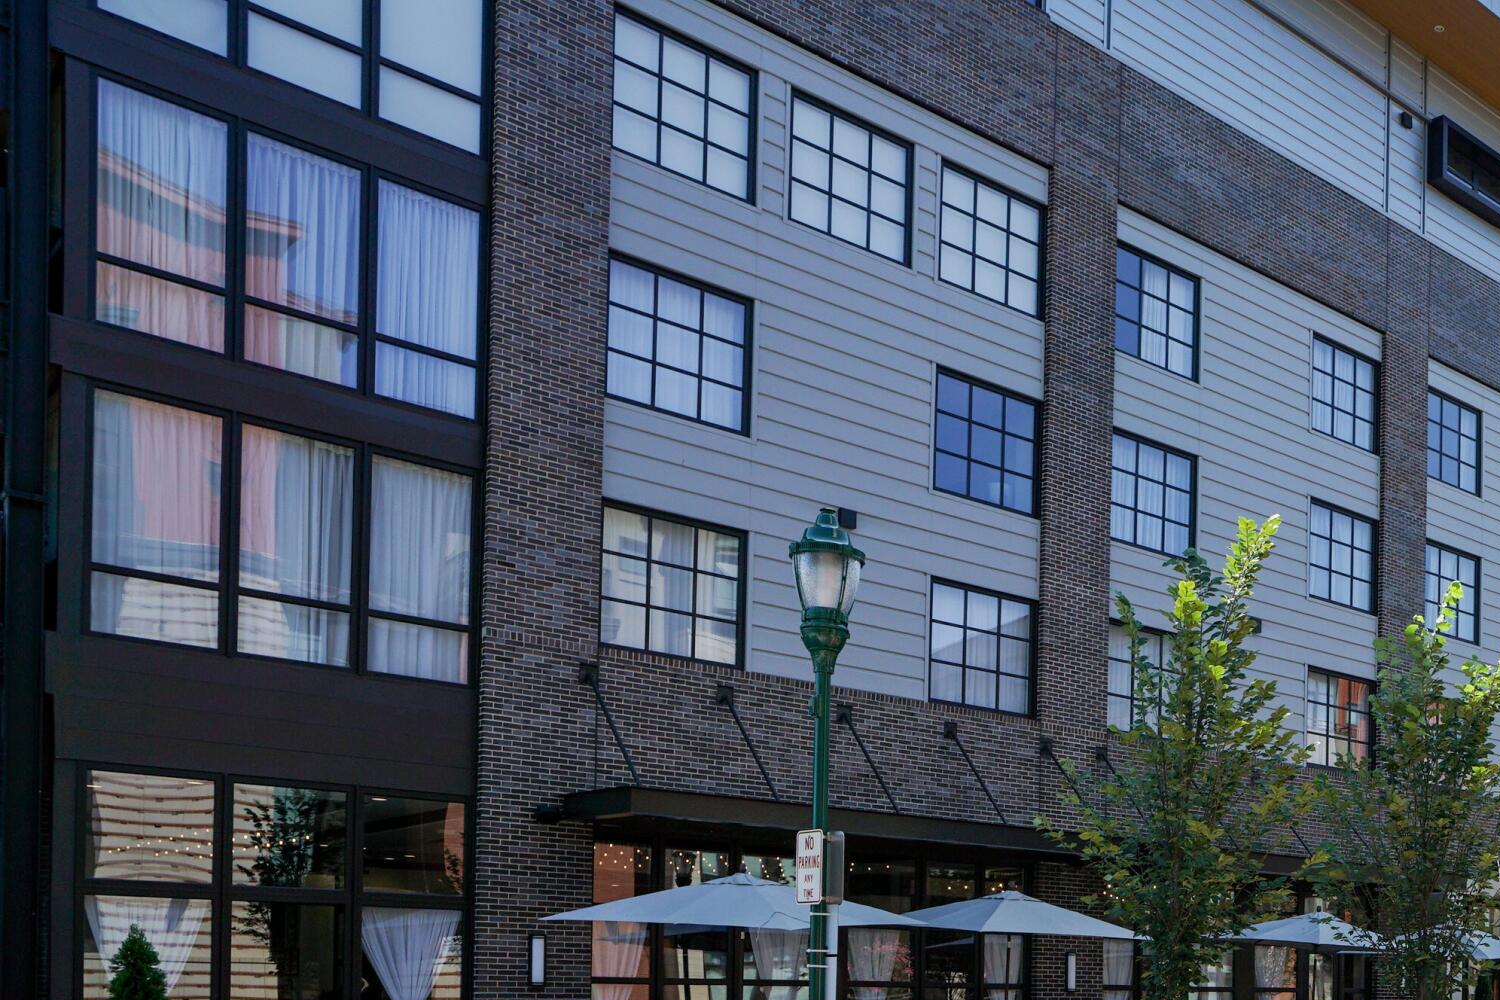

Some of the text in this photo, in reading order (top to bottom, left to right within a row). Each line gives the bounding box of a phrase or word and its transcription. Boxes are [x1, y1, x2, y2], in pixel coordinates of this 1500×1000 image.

[805, 837, 814, 850] NO
[798, 855, 820, 869] PARKING
[804, 874, 813, 883] ANY
[803, 888, 813, 897] TIME
